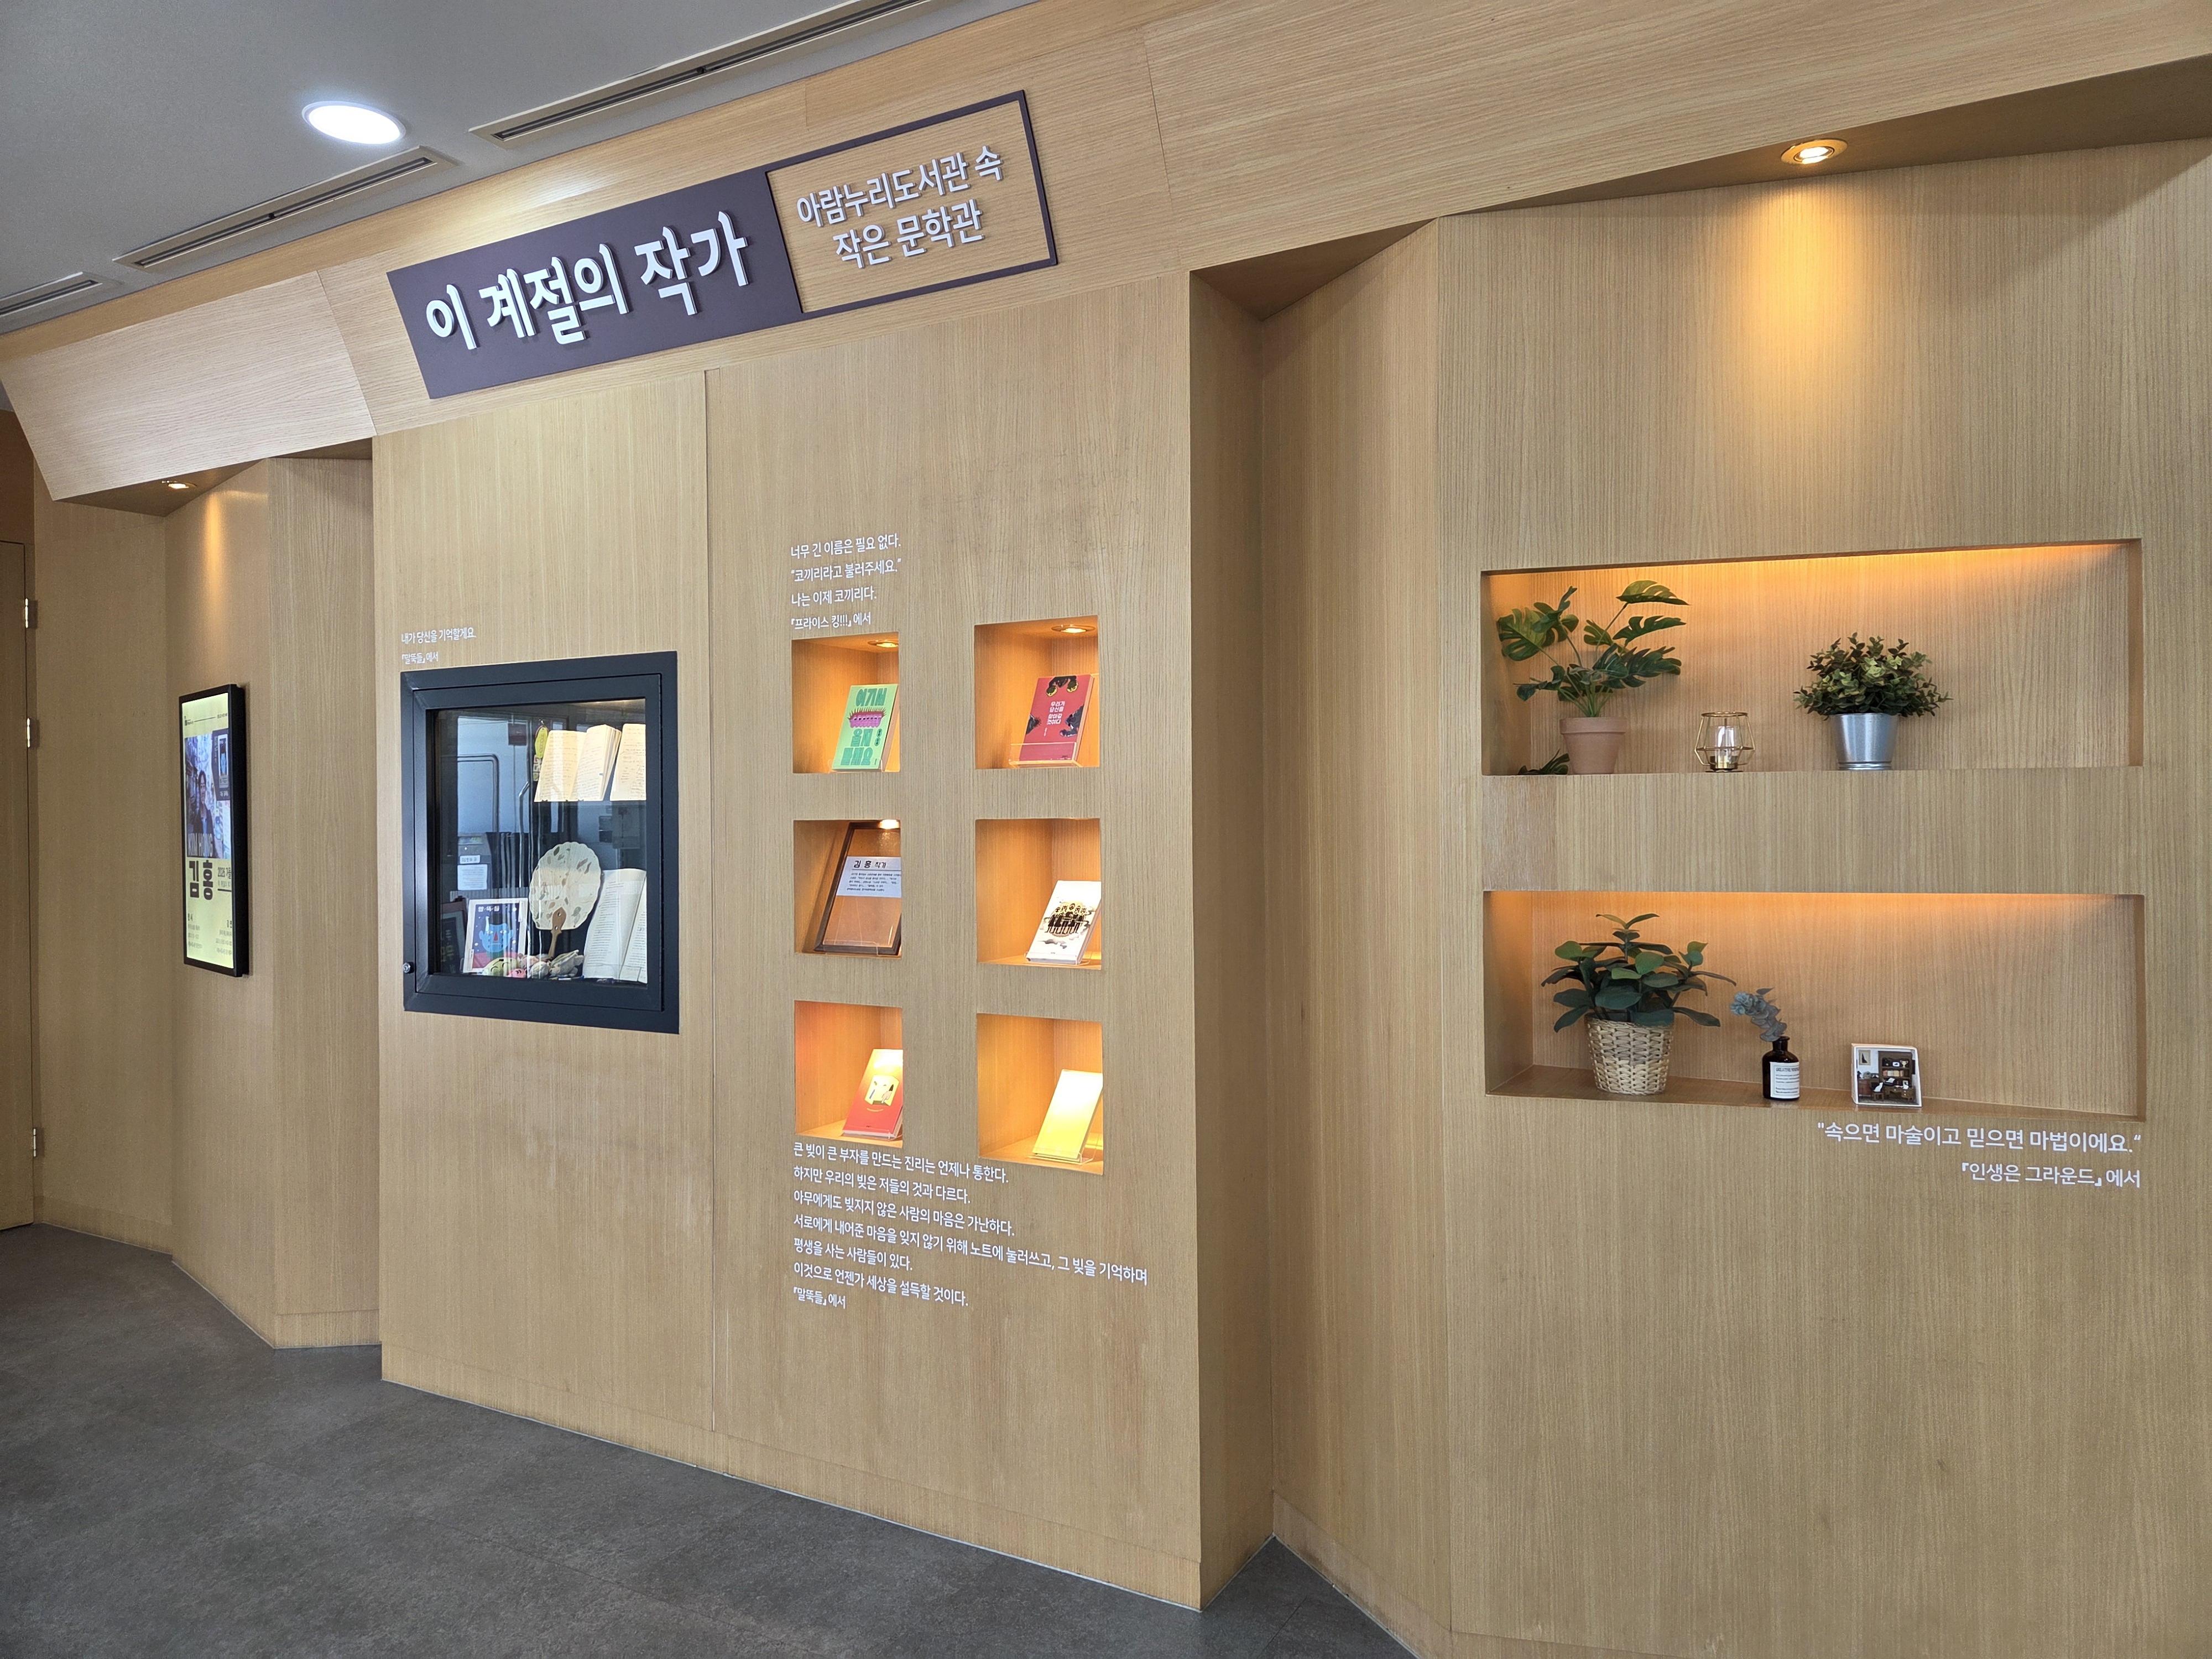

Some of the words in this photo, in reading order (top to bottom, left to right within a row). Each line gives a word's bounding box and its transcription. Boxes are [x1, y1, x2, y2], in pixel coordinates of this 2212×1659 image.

[795, 151, 971, 231] 아람누리도서관
[974, 146, 1001, 181] 속
[833, 222, 891, 269] 작은
[896, 197, 984, 258] 문학관
[426, 285, 478, 351] 이
[479, 242, 629, 345] 계절의
[634, 210, 749, 316] 작가
[791, 545, 810, 559] 너무
[812, 542, 821, 557] 긴
[824, 539, 854, 555] 이름은
[855, 536, 875, 552] 필요
[877, 533, 901, 550] 없다.
[791, 593, 811, 607] 나는
[813, 589, 832, 605] 이제
[835, 585, 877, 603] 코끼리다.
[853, 611, 871, 626] 에서
[401, 632, 416, 644] 내가
[416, 630, 437, 644] 당신을
[439, 627, 477, 641] 기억할게요
[426, 651, 438, 662] 에서
[188, 832, 198, 856] KIM
[854, 860, 861, 868] 김
[1886, 1125, 1963, 1146] 마술이고
[1968, 1128, 2024, 1150] 믿으면
[793, 1141, 804, 1156] 큰
[807, 1144, 825, 1160] 빚이
[827, 1147, 837, 1160] 큰
[839, 1147, 869, 1165] 부자를
[872, 1152, 902, 1169] 만드는
[905, 1157, 936, 1174] 진리는
[939, 1161, 971, 1179] 언제나
[973, 1165, 1009, 1183] 통한다.
[794, 1166, 823, 1183] 하지만
[825, 1170, 854, 1188] 우리의
[858, 1174, 877, 1191] 빚은
[879, 1177, 909, 1196] 저들의
[912, 1182, 933, 1199] 것과
[936, 1186, 971, 1204] 다르다.
[2106, 1169, 2141, 1189] 에서
[795, 1190, 842, 1209] 아무에게도
[846, 1197, 874, 1215] 빚지지
[878, 1203, 897, 1218] 않은
[899, 1206, 930, 1224] 사람의
[934, 1211, 965, 1229] 마음은
[968, 1217, 1015, 1237] 가난하다.
[794, 1214, 832, 1233] 서로에게
[836, 1221, 864, 1238] 내어준
[868, 1226, 897, 1244] 마음을
[900, 1230, 920, 1248] 잊지
[924, 1234, 943, 1252] 않기
[946, 1238, 968, 1256] 위해
[971, 1242, 1003, 1261] 노트에
[1006, 1247, 1055, 1270] 눌러쓰고,
[1058, 1256, 1070, 1271] 그
[1073, 1258, 1097, 1277] 빚을
[1099, 1262, 1147, 1286] 기억하며
[795, 1238, 823, 1256] 평생을
[825, 1244, 845, 1260] 사는
[847, 1247, 886, 1267] 사람들이
[889, 1253, 913, 1271] 있다.
[795, 1263, 832, 1281] 이것으로
[834, 1269, 864, 1288] 언젠가
[867, 1276, 897, 1294] 세상을
[900, 1280, 931, 1301] 설득할
[933, 1287, 968, 1307] 것이다.
[829, 1295, 846, 1310] 에서
